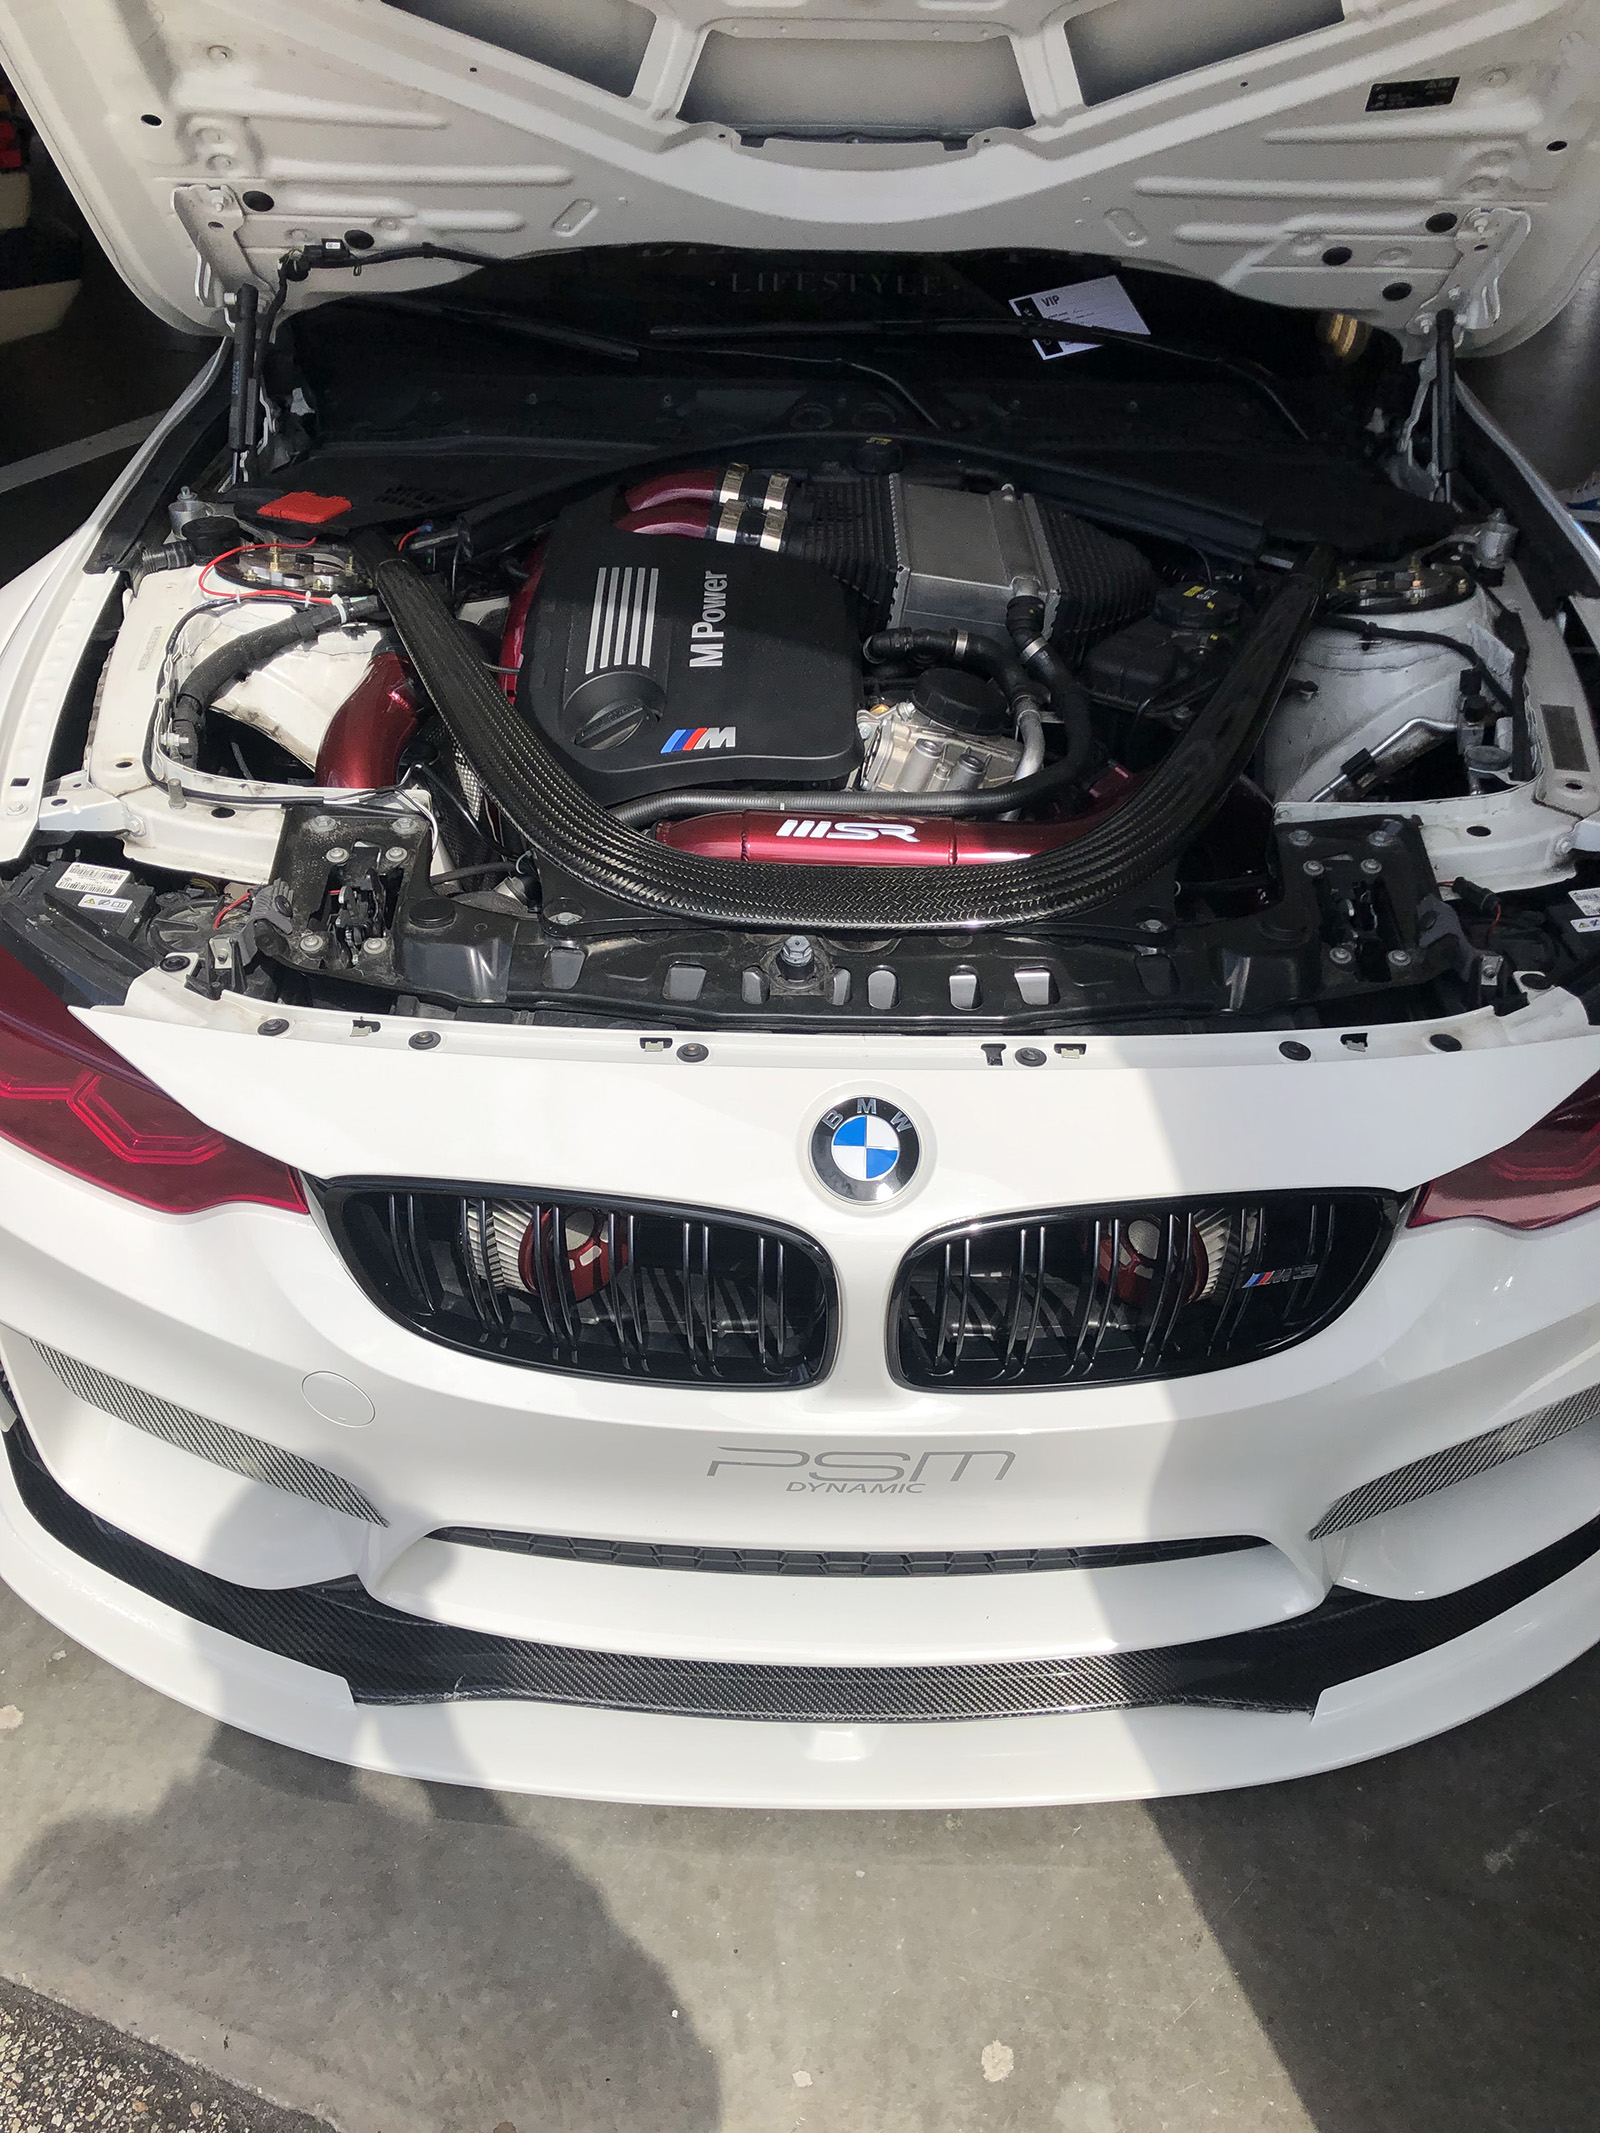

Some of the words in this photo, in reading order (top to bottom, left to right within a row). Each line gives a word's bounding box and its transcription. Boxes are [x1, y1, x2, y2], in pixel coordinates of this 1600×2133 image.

[1041, 295, 1060, 307] VIP
[822, 1098, 913, 1133] BMW
[785, 1481, 927, 1494] DYNAMIC
